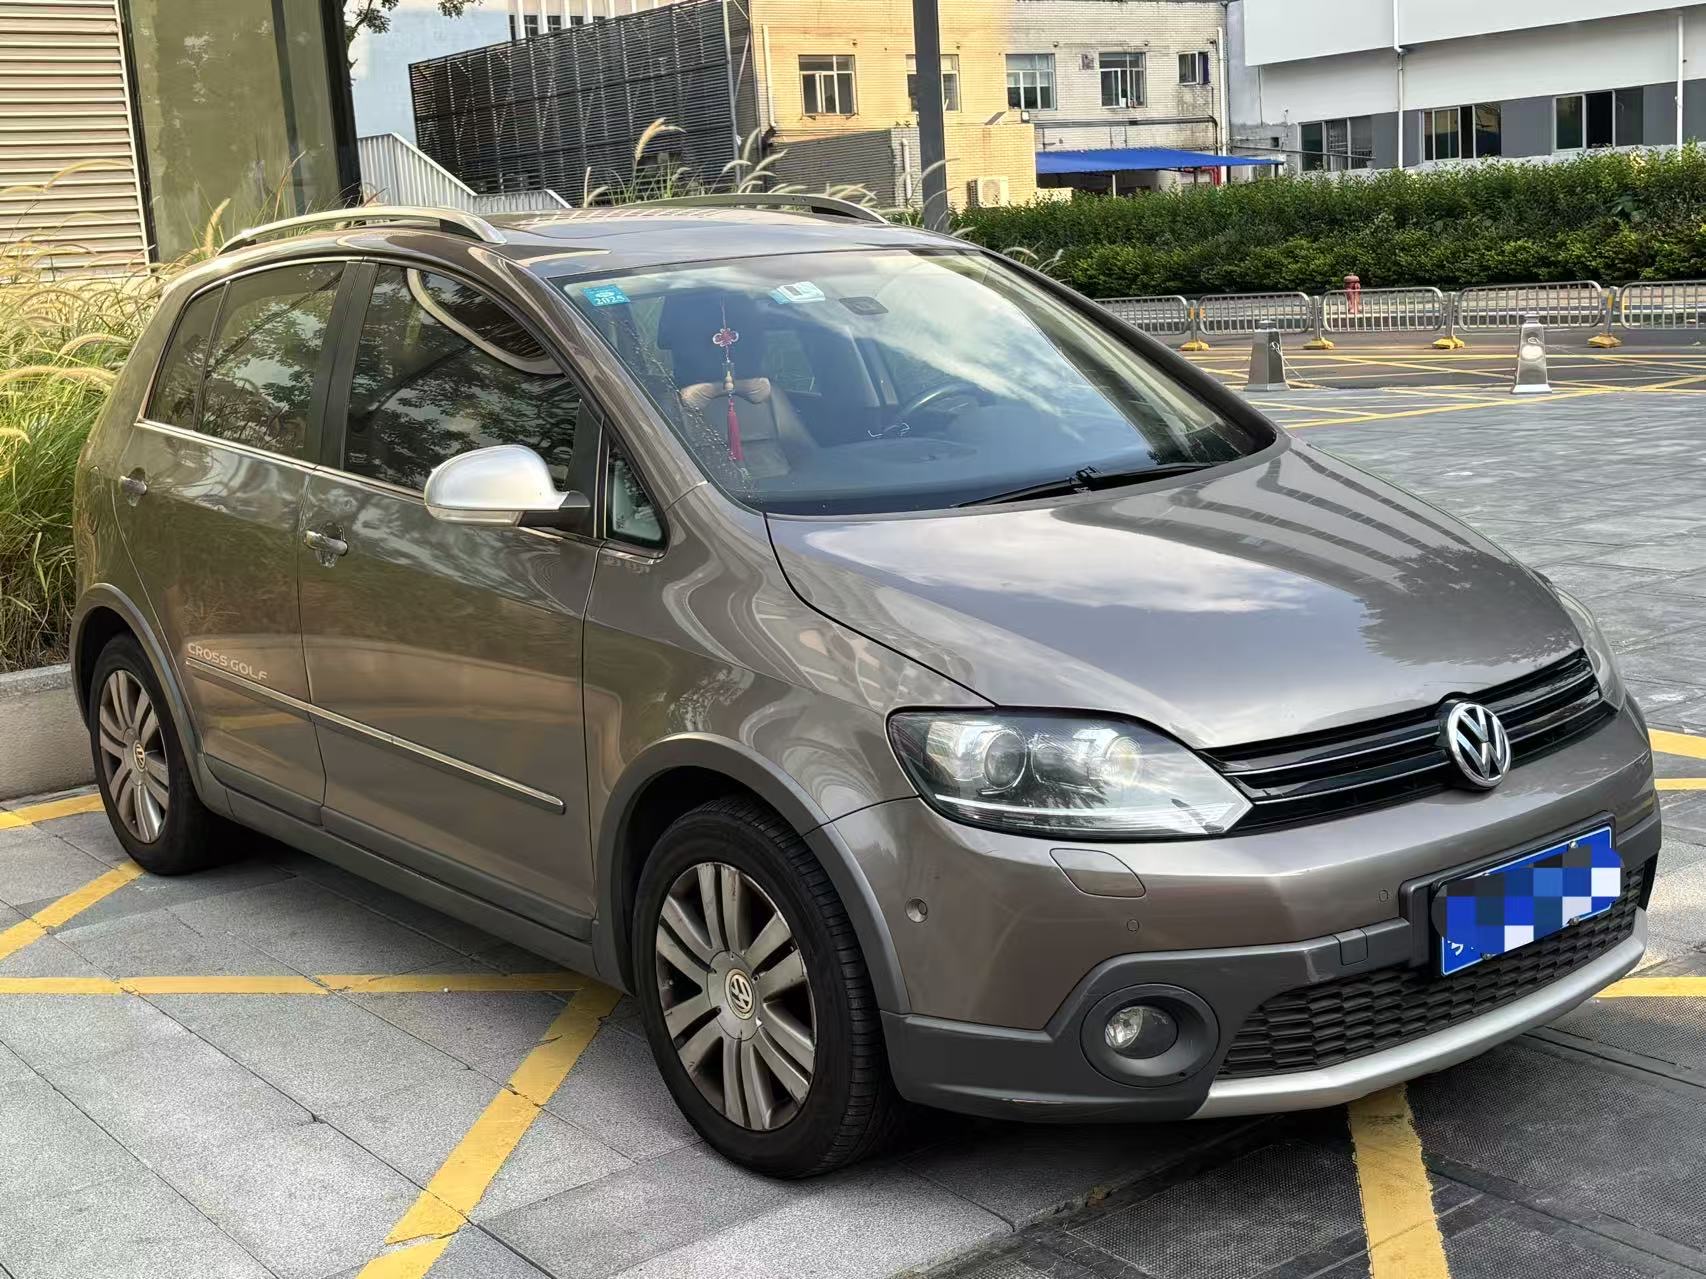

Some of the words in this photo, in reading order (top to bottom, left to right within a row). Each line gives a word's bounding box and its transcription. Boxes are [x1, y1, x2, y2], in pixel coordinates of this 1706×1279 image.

[187, 642, 228, 667] CROSS
[230, 659, 268, 681] GOLF
[1448, 702, 1511, 787] VW
